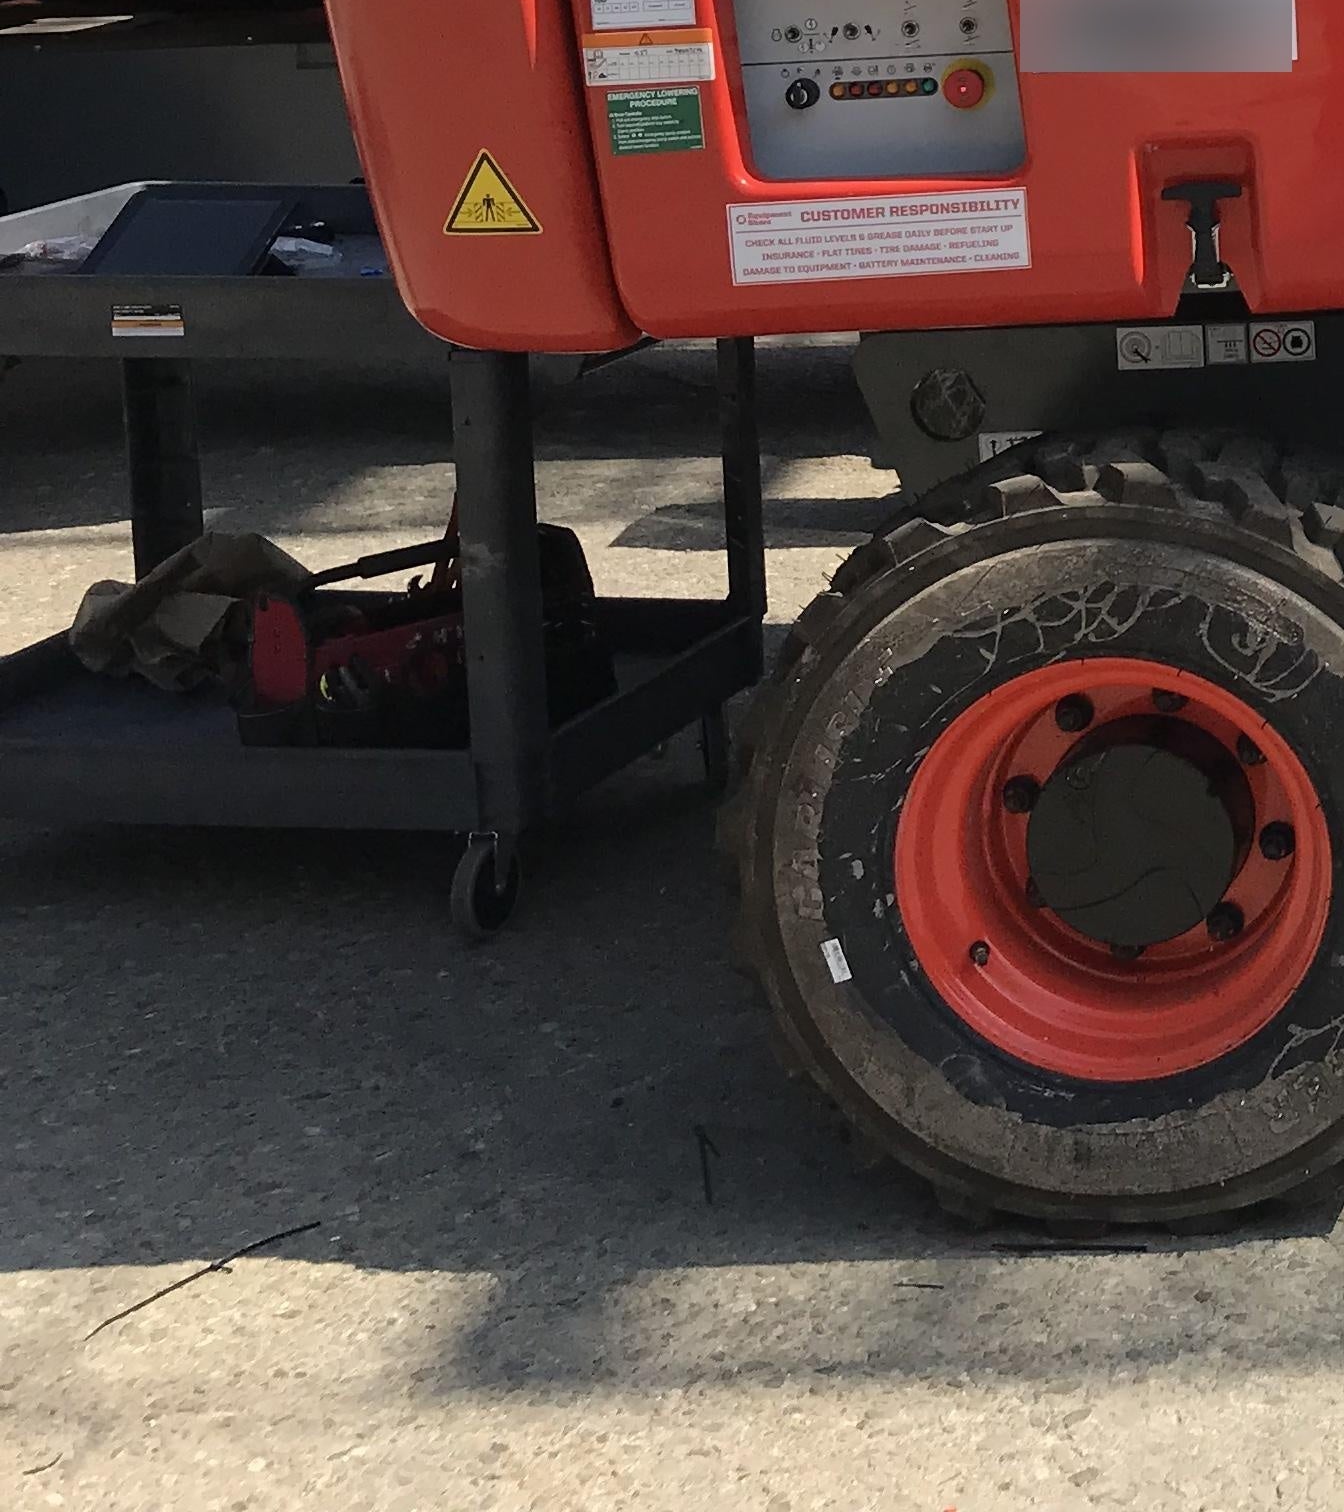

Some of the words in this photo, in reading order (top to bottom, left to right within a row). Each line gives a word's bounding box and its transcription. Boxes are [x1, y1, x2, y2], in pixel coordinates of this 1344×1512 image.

[607, 92, 656, 101] EMERGENCY
[657, 88, 698, 98] LOWERING
[629, 98, 678, 108] PROCEDURE
[800, 207, 886, 223] CUSTOMER
[890, 199, 1020, 217] RESPONSIBILITY
[745, 238, 776, 248] CHECK
[778, 236, 793, 246] ALL
[795, 235, 822, 244] FLUID
[824, 234, 856, 243] LEVELS
[905, 230, 931, 239] DAILY
[970, 226, 999, 235] START
[762, 250, 814, 261] INSURANCE
[822, 248, 844, 258] FLAT
[845, 247, 872, 256] TIRES
[880, 245, 901, 254] TIRE
[903, 242, 942, 253] DAMAGE
[949, 239, 999, 250] REFUELING
[743, 266, 781, 276] DAMAGE
[784, 264, 795, 274] TO
[798, 262, 852, 274] EQUIPMENT
[859, 259, 898, 269] BATTERY
[900, 255, 967, 267] MAINTENANCE
[974, 252, 1020, 262] CLEANING
